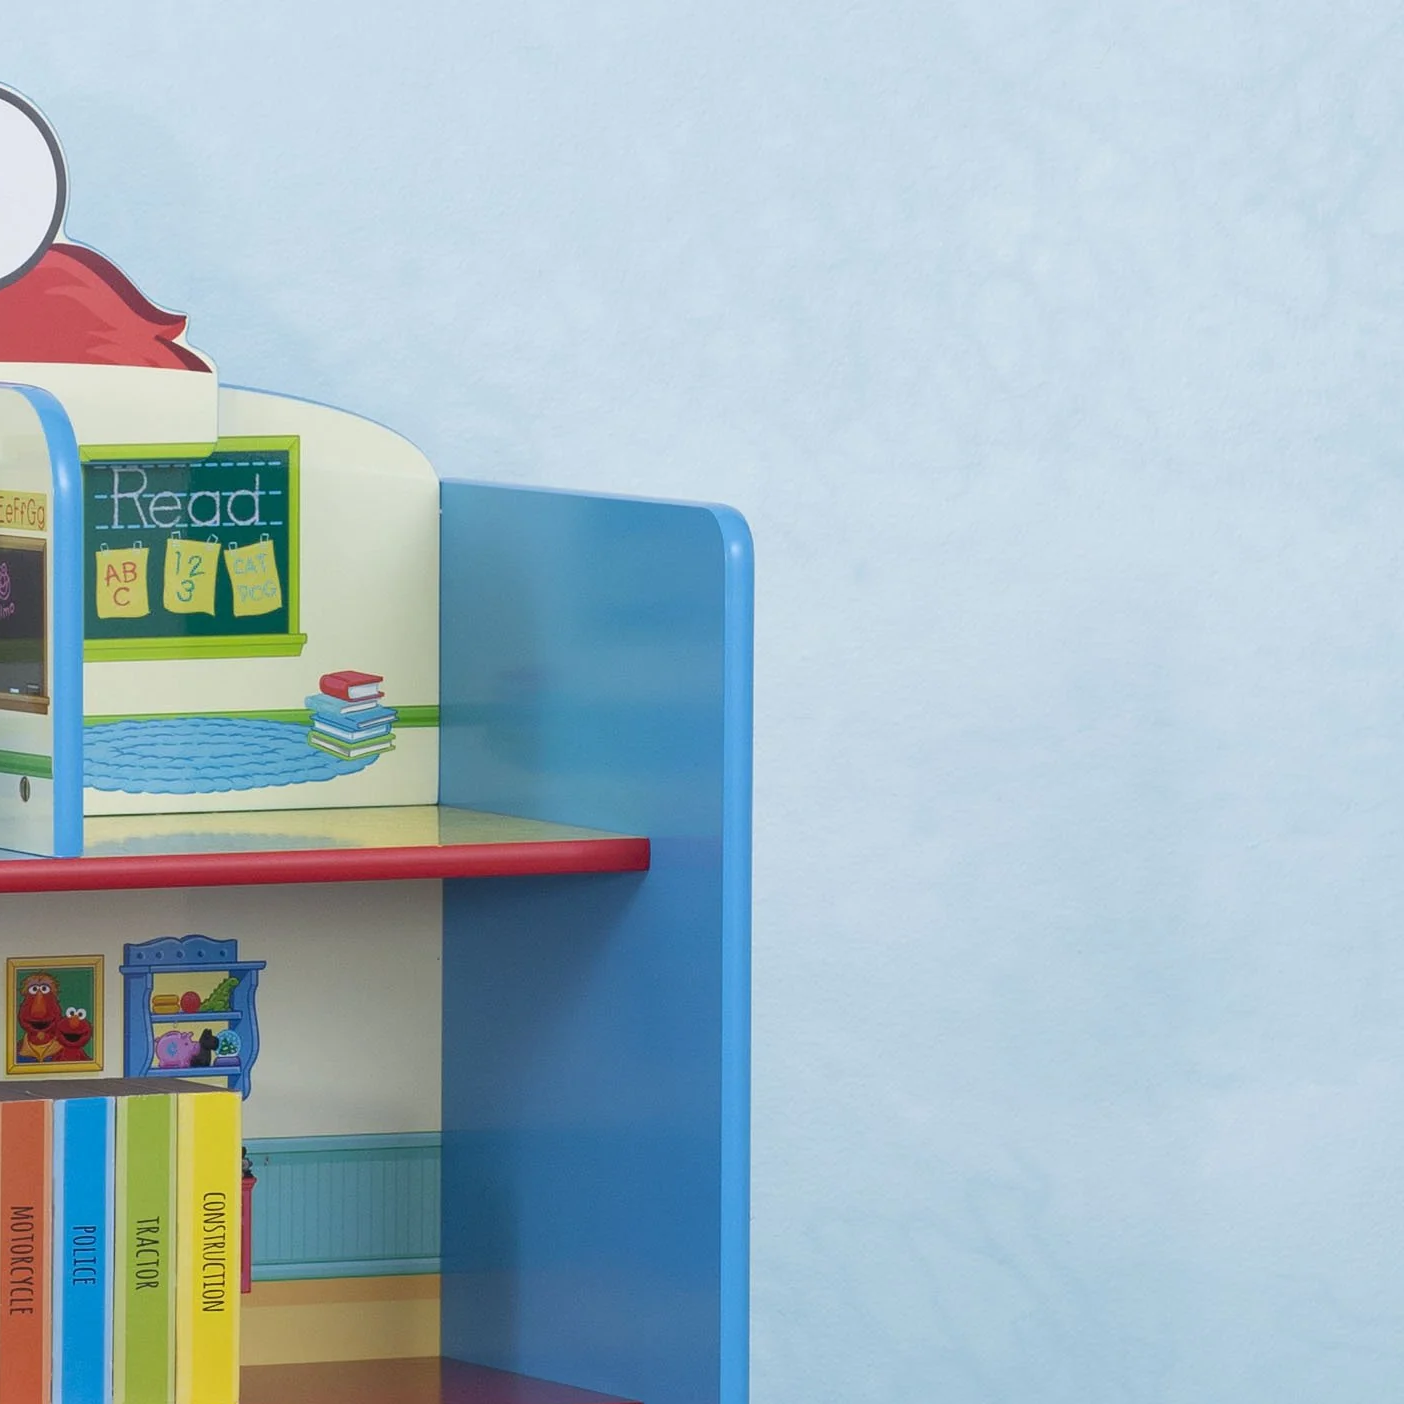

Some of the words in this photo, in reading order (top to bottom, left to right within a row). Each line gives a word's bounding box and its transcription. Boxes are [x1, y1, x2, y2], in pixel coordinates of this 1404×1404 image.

[111, 466, 260, 528] Read
[9, 1205, 34, 1316] MOTORCYCLE
[72, 1225, 97, 1286] POLICE
[135, 1215, 160, 1291] TRACTOR
[202, 1192, 226, 1313] CONSTRUCTION
